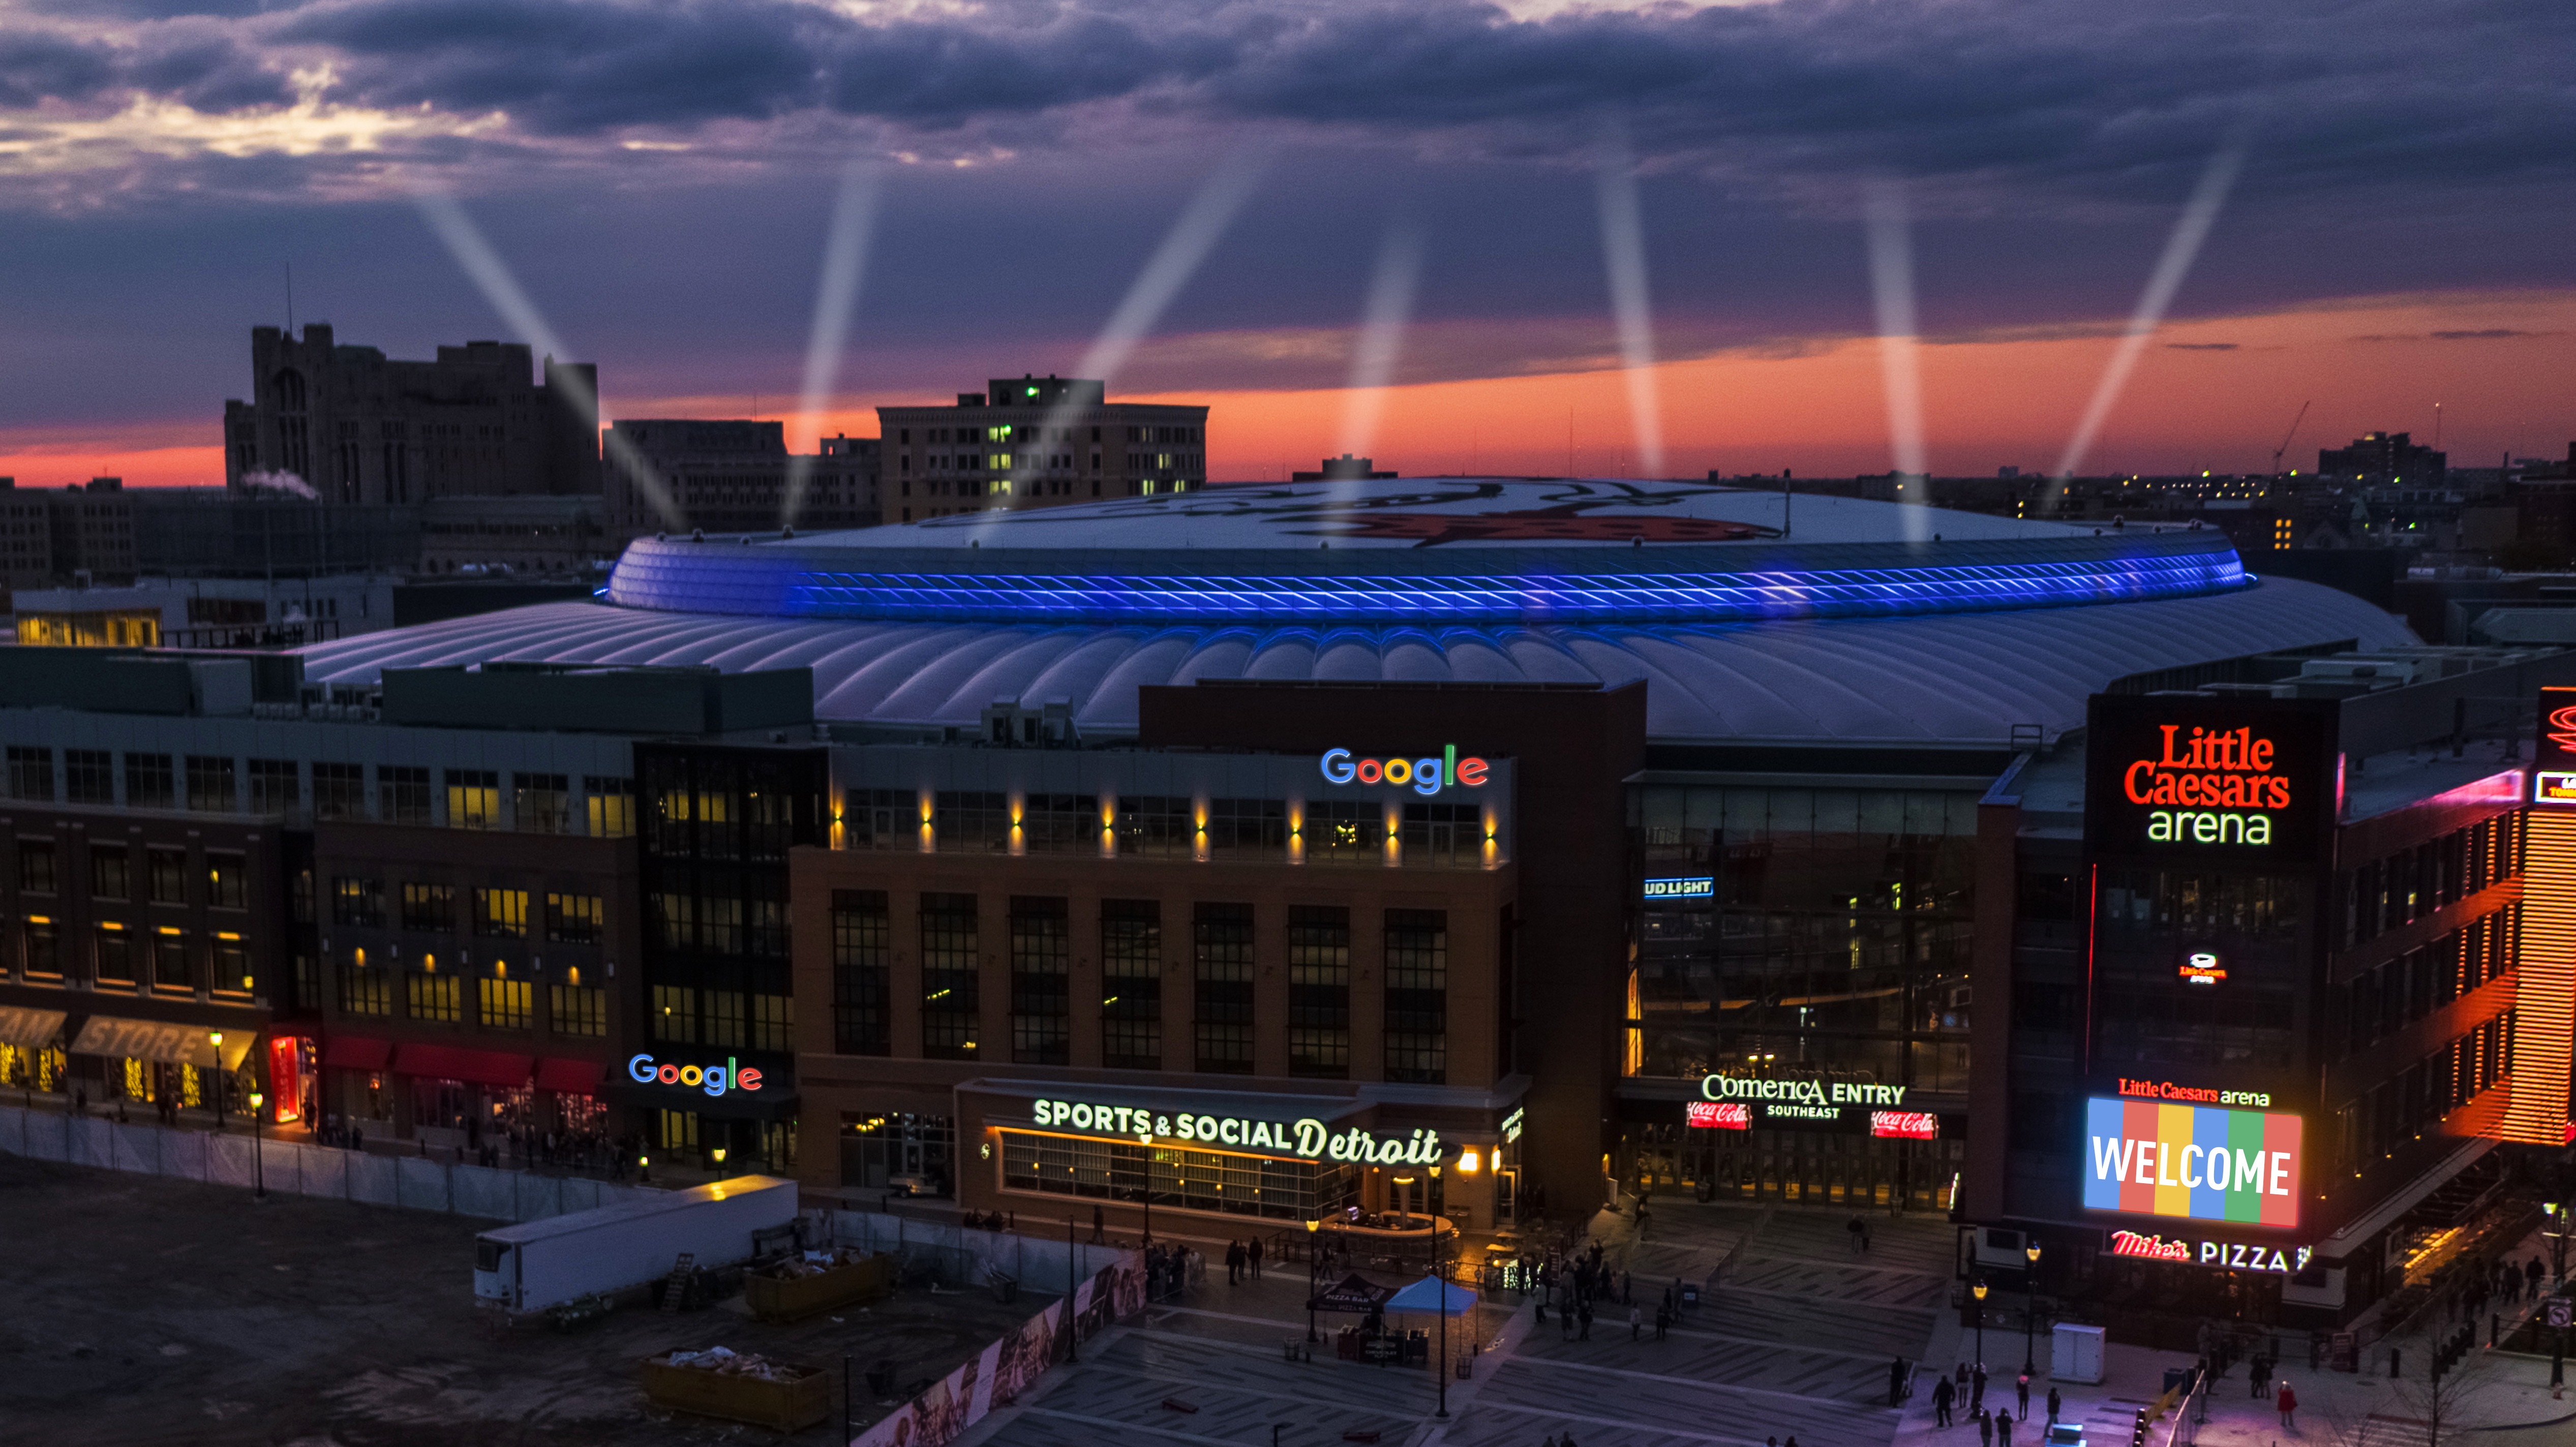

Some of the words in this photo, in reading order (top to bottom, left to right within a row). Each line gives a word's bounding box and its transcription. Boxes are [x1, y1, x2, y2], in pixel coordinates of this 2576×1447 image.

[2158, 725, 2274, 771] Little
[1320, 745, 1490, 795] Google
[2124, 760, 2290, 809] Caesars
[2147, 810, 2271, 845] arena
[1645, 883, 1666, 895] UD
[1668, 881, 1711, 894] LIGHT
[82, 1020, 205, 1060] STORE
[628, 1053, 763, 1096] Google
[1832, 1083, 1905, 1105] ENTRY
[2118, 1078, 2159, 1098] Little
[2160, 1081, 2218, 1102] Caesars
[2220, 1090, 2270, 1106] arena
[1034, 1099, 1151, 1134] SPORTS
[1156, 1116, 1171, 1137] &
[1176, 1113, 1292, 1150] SOCIAL
[1293, 1118, 1442, 1164] Detroit
[1767, 1105, 1840, 1119] SOUTHEAST
[2093, 1136, 2291, 1196] WELCOME
[2111, 1230, 2191, 1260] Mike's
[2201, 1241, 2288, 1272] PIZZA
